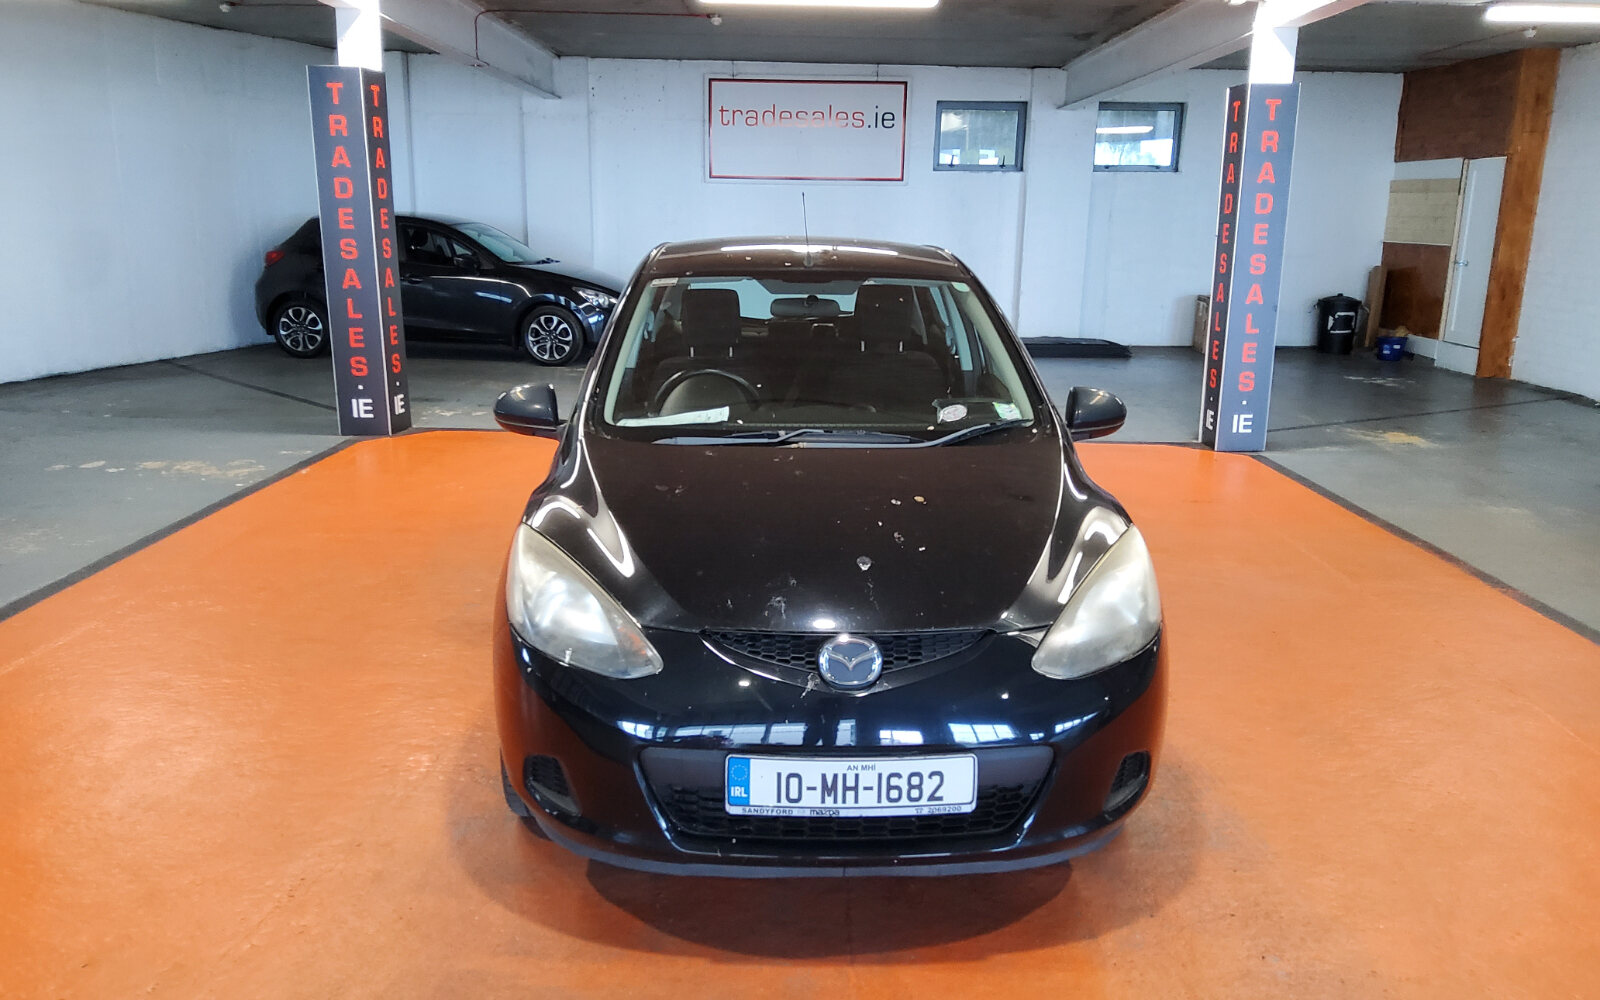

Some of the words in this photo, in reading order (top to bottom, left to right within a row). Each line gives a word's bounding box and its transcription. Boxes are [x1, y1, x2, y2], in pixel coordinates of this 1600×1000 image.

[718, 103, 896, 129] tradesales.ie
[730, 786, 748, 798] IRL
[776, 770, 945, 804] 10-MH-1682
[741, 807, 794, 815] SANDYFORD
